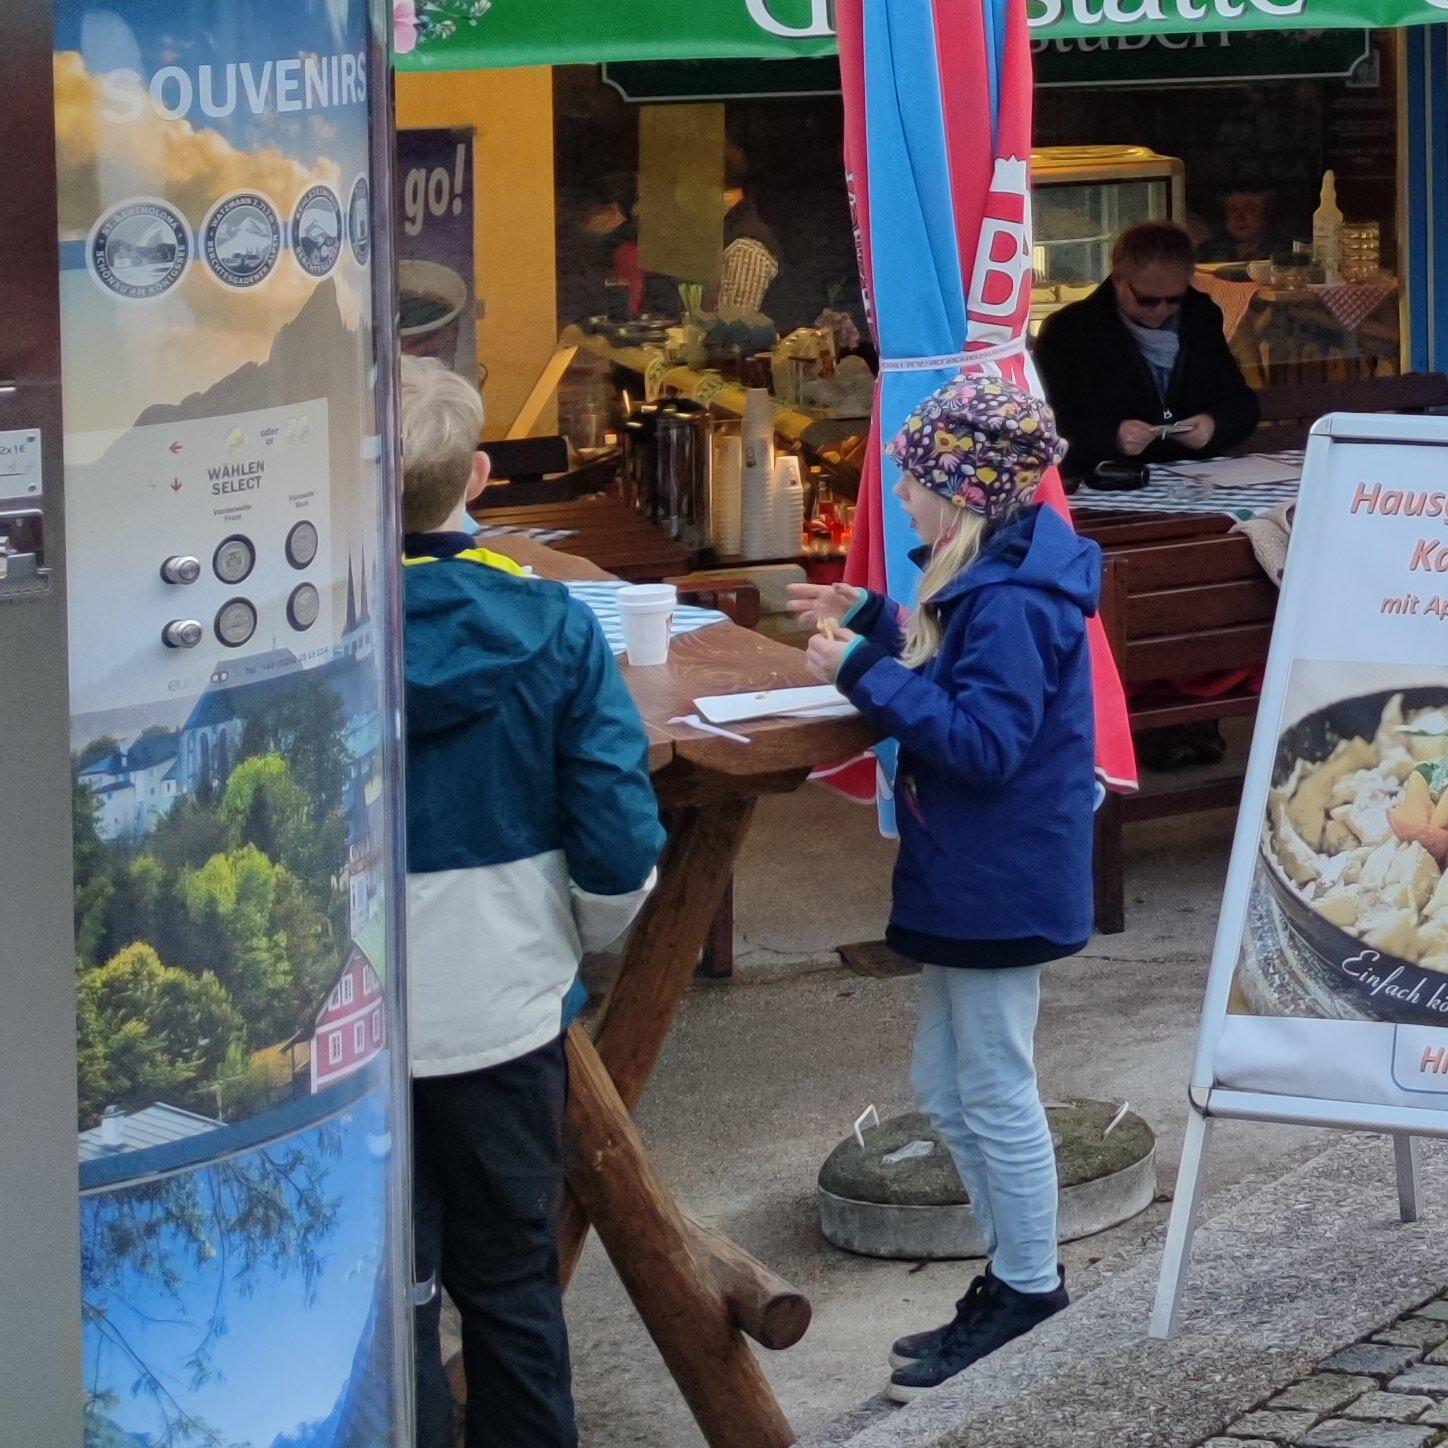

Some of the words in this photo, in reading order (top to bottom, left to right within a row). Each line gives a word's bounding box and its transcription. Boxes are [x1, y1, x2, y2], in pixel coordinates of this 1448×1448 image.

[101, 50, 367, 125] SOUVENIRS
[404, 142, 466, 236] go!
[211, 475, 263, 496] SELECT
[1379, 593, 1420, 615] mit
[1341, 949, 1421, 1006] Einfach
